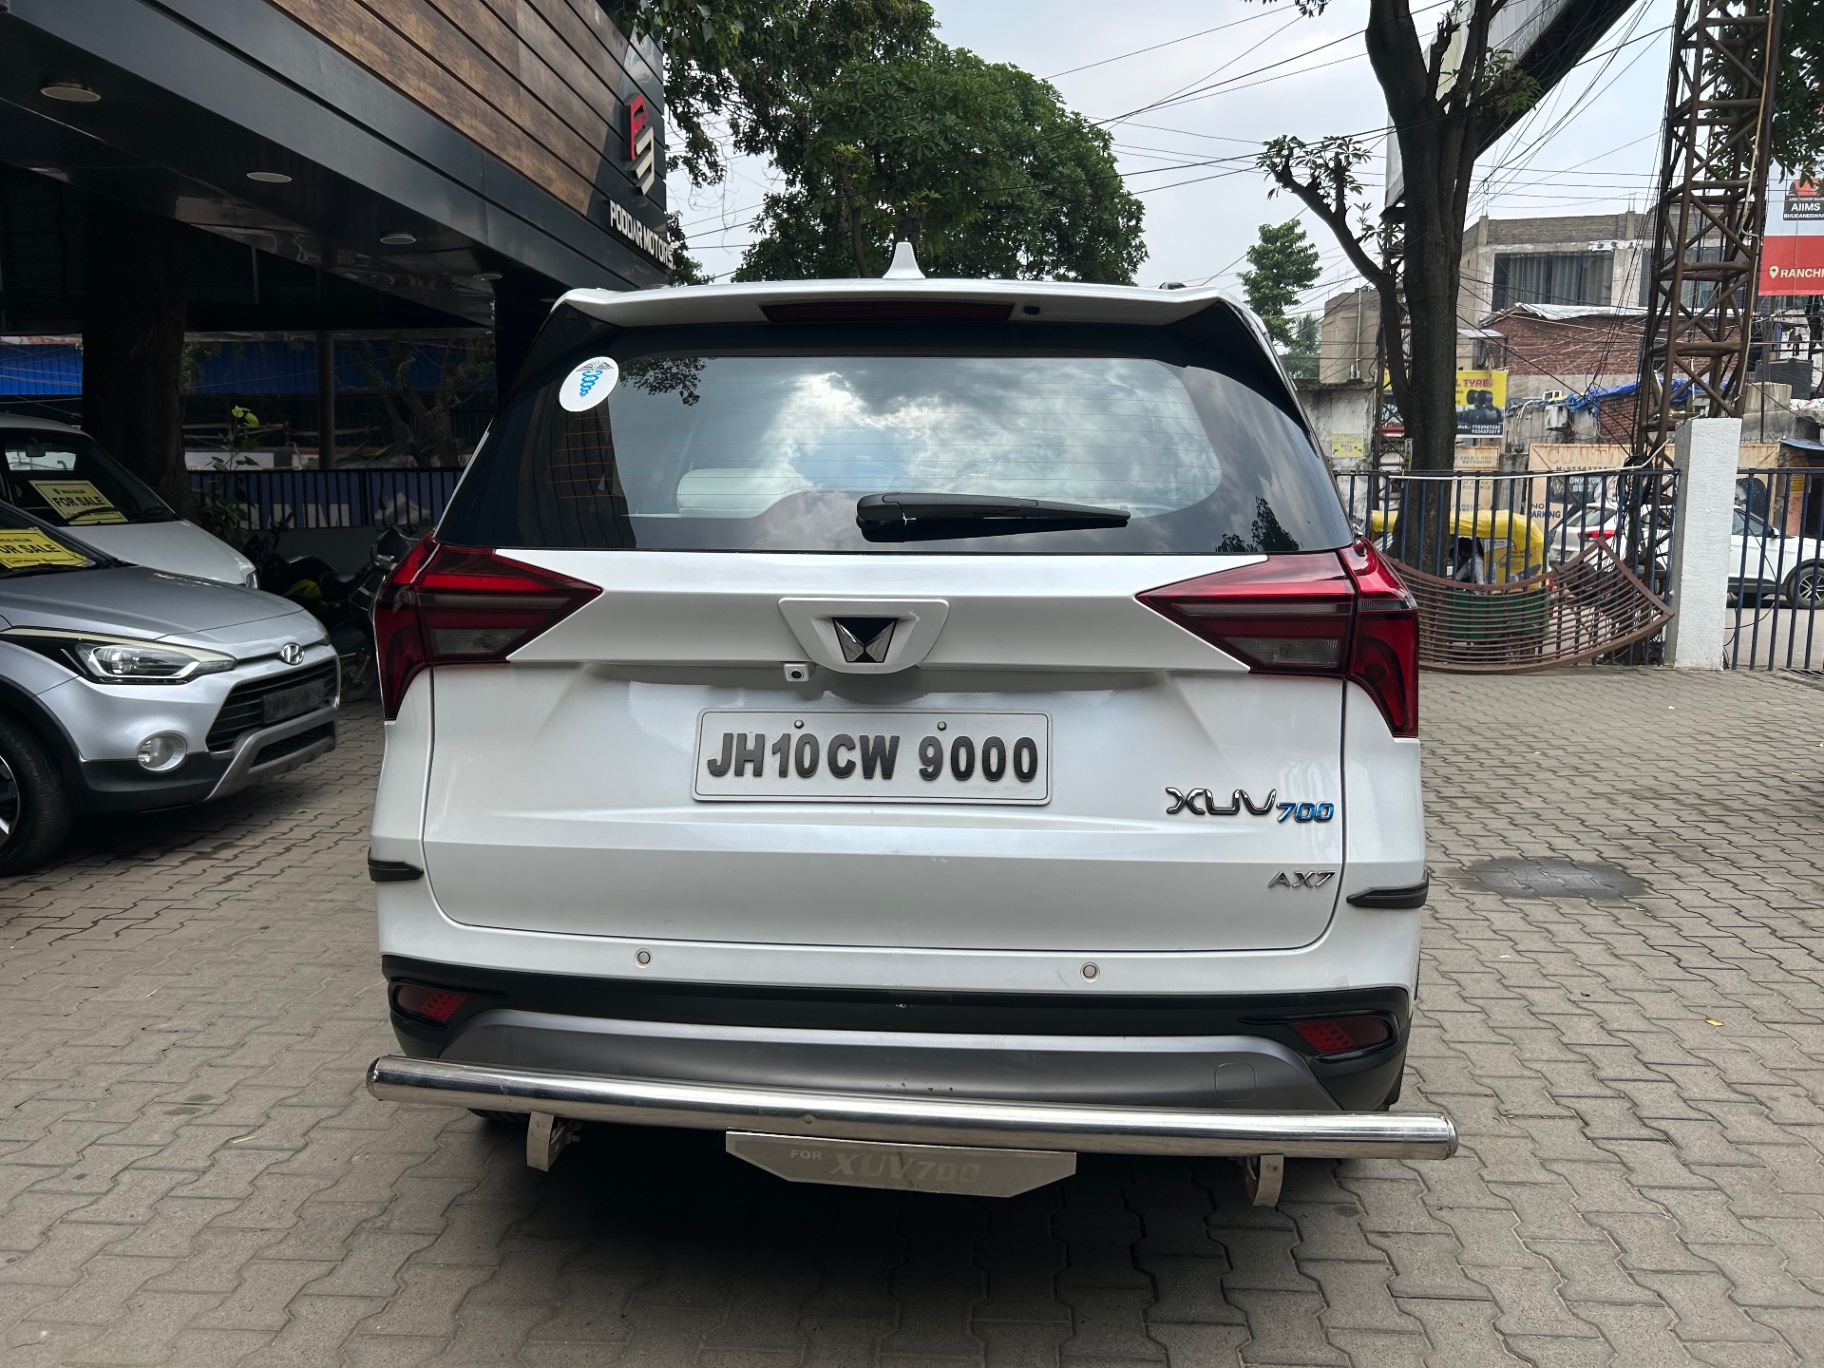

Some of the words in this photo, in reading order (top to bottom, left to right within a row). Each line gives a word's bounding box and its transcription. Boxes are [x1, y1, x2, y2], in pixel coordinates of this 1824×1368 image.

[1790, 202, 1821, 212] AIIMS
[609, 199, 643, 249] PODDAR
[642, 225, 674, 270] MOTORS
[51, 497, 79, 507] FOR
[75, 496, 106, 506] SALE
[18, 543, 62, 554] SALE
[707, 732, 900, 780] JH10CW
[918, 735, 1038, 782] 9000
[1268, 870, 1336, 888] AX7
[789, 1149, 823, 1161] FOR
